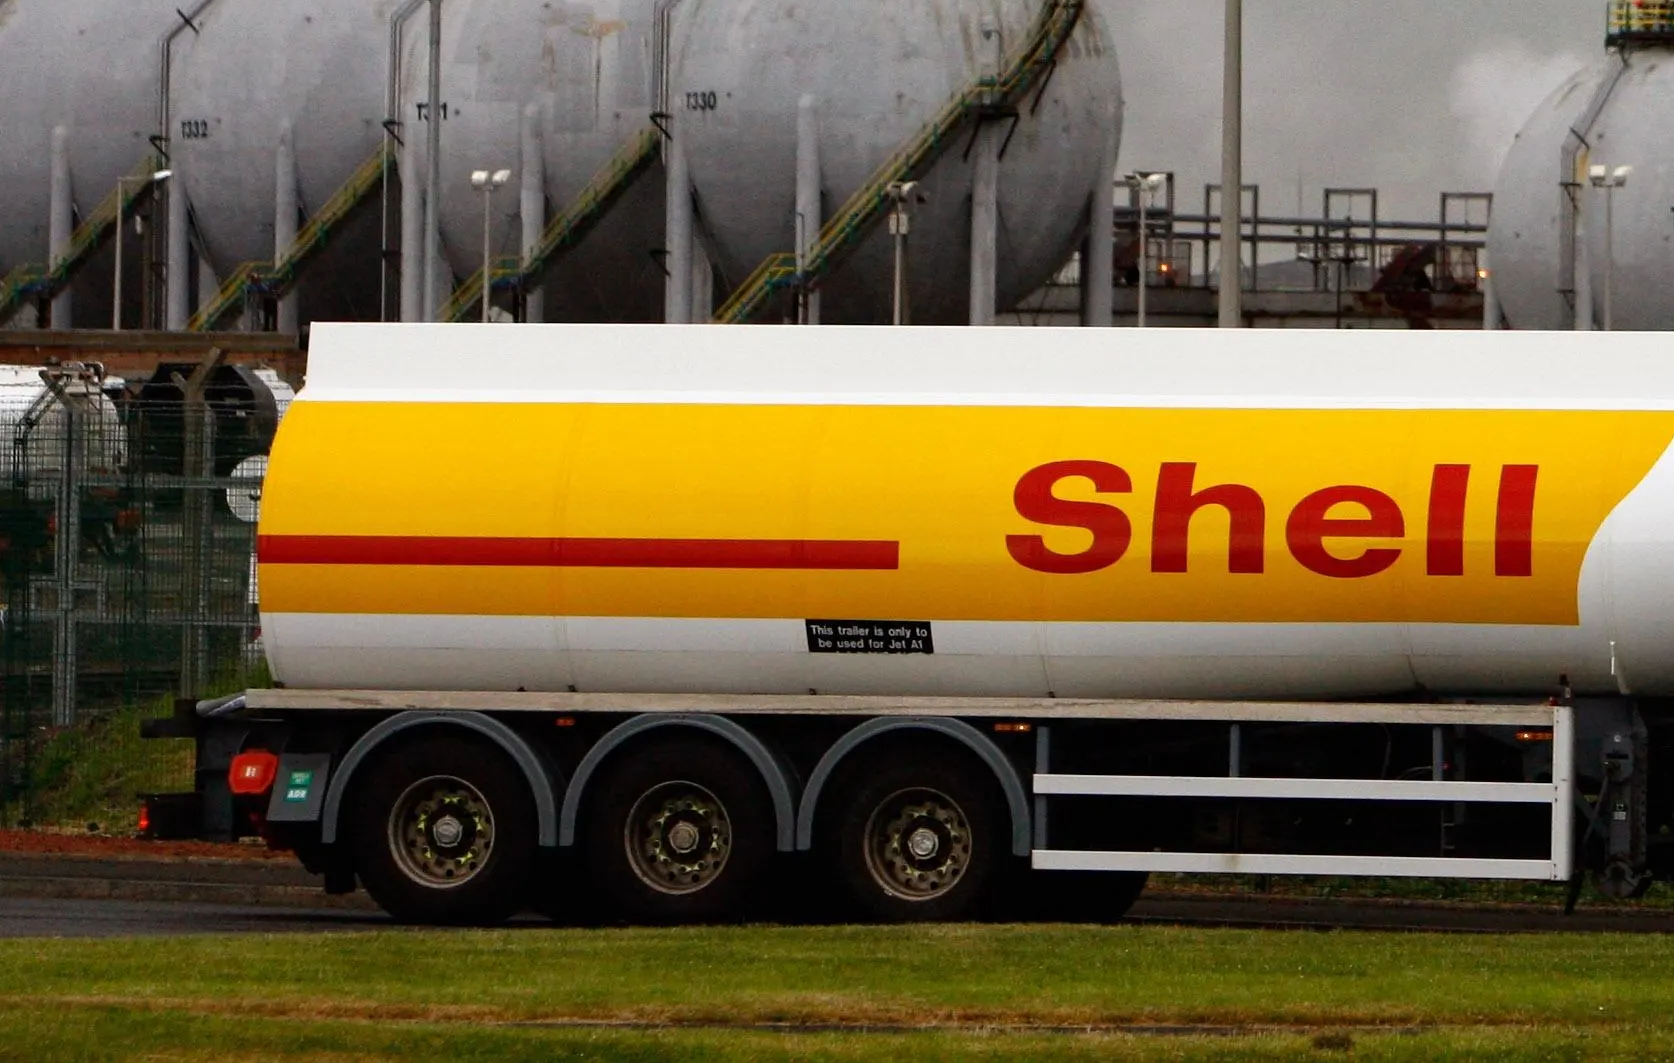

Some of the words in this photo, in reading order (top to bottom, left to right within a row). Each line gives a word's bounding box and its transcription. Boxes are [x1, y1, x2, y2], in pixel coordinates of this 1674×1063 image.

[1006, 459, 1539, 578] Shell
[810, 625, 833, 636] This
[838, 625, 869, 636] trailer
[873, 625, 884, 636] is
[888, 626, 911, 638] only
[916, 627, 928, 637] to
[818, 638, 832, 648] be
[837, 638, 864, 649] used
[869, 638, 884, 649] for
[889, 639, 906, 649] Jet
[911, 639, 923, 649] A1
